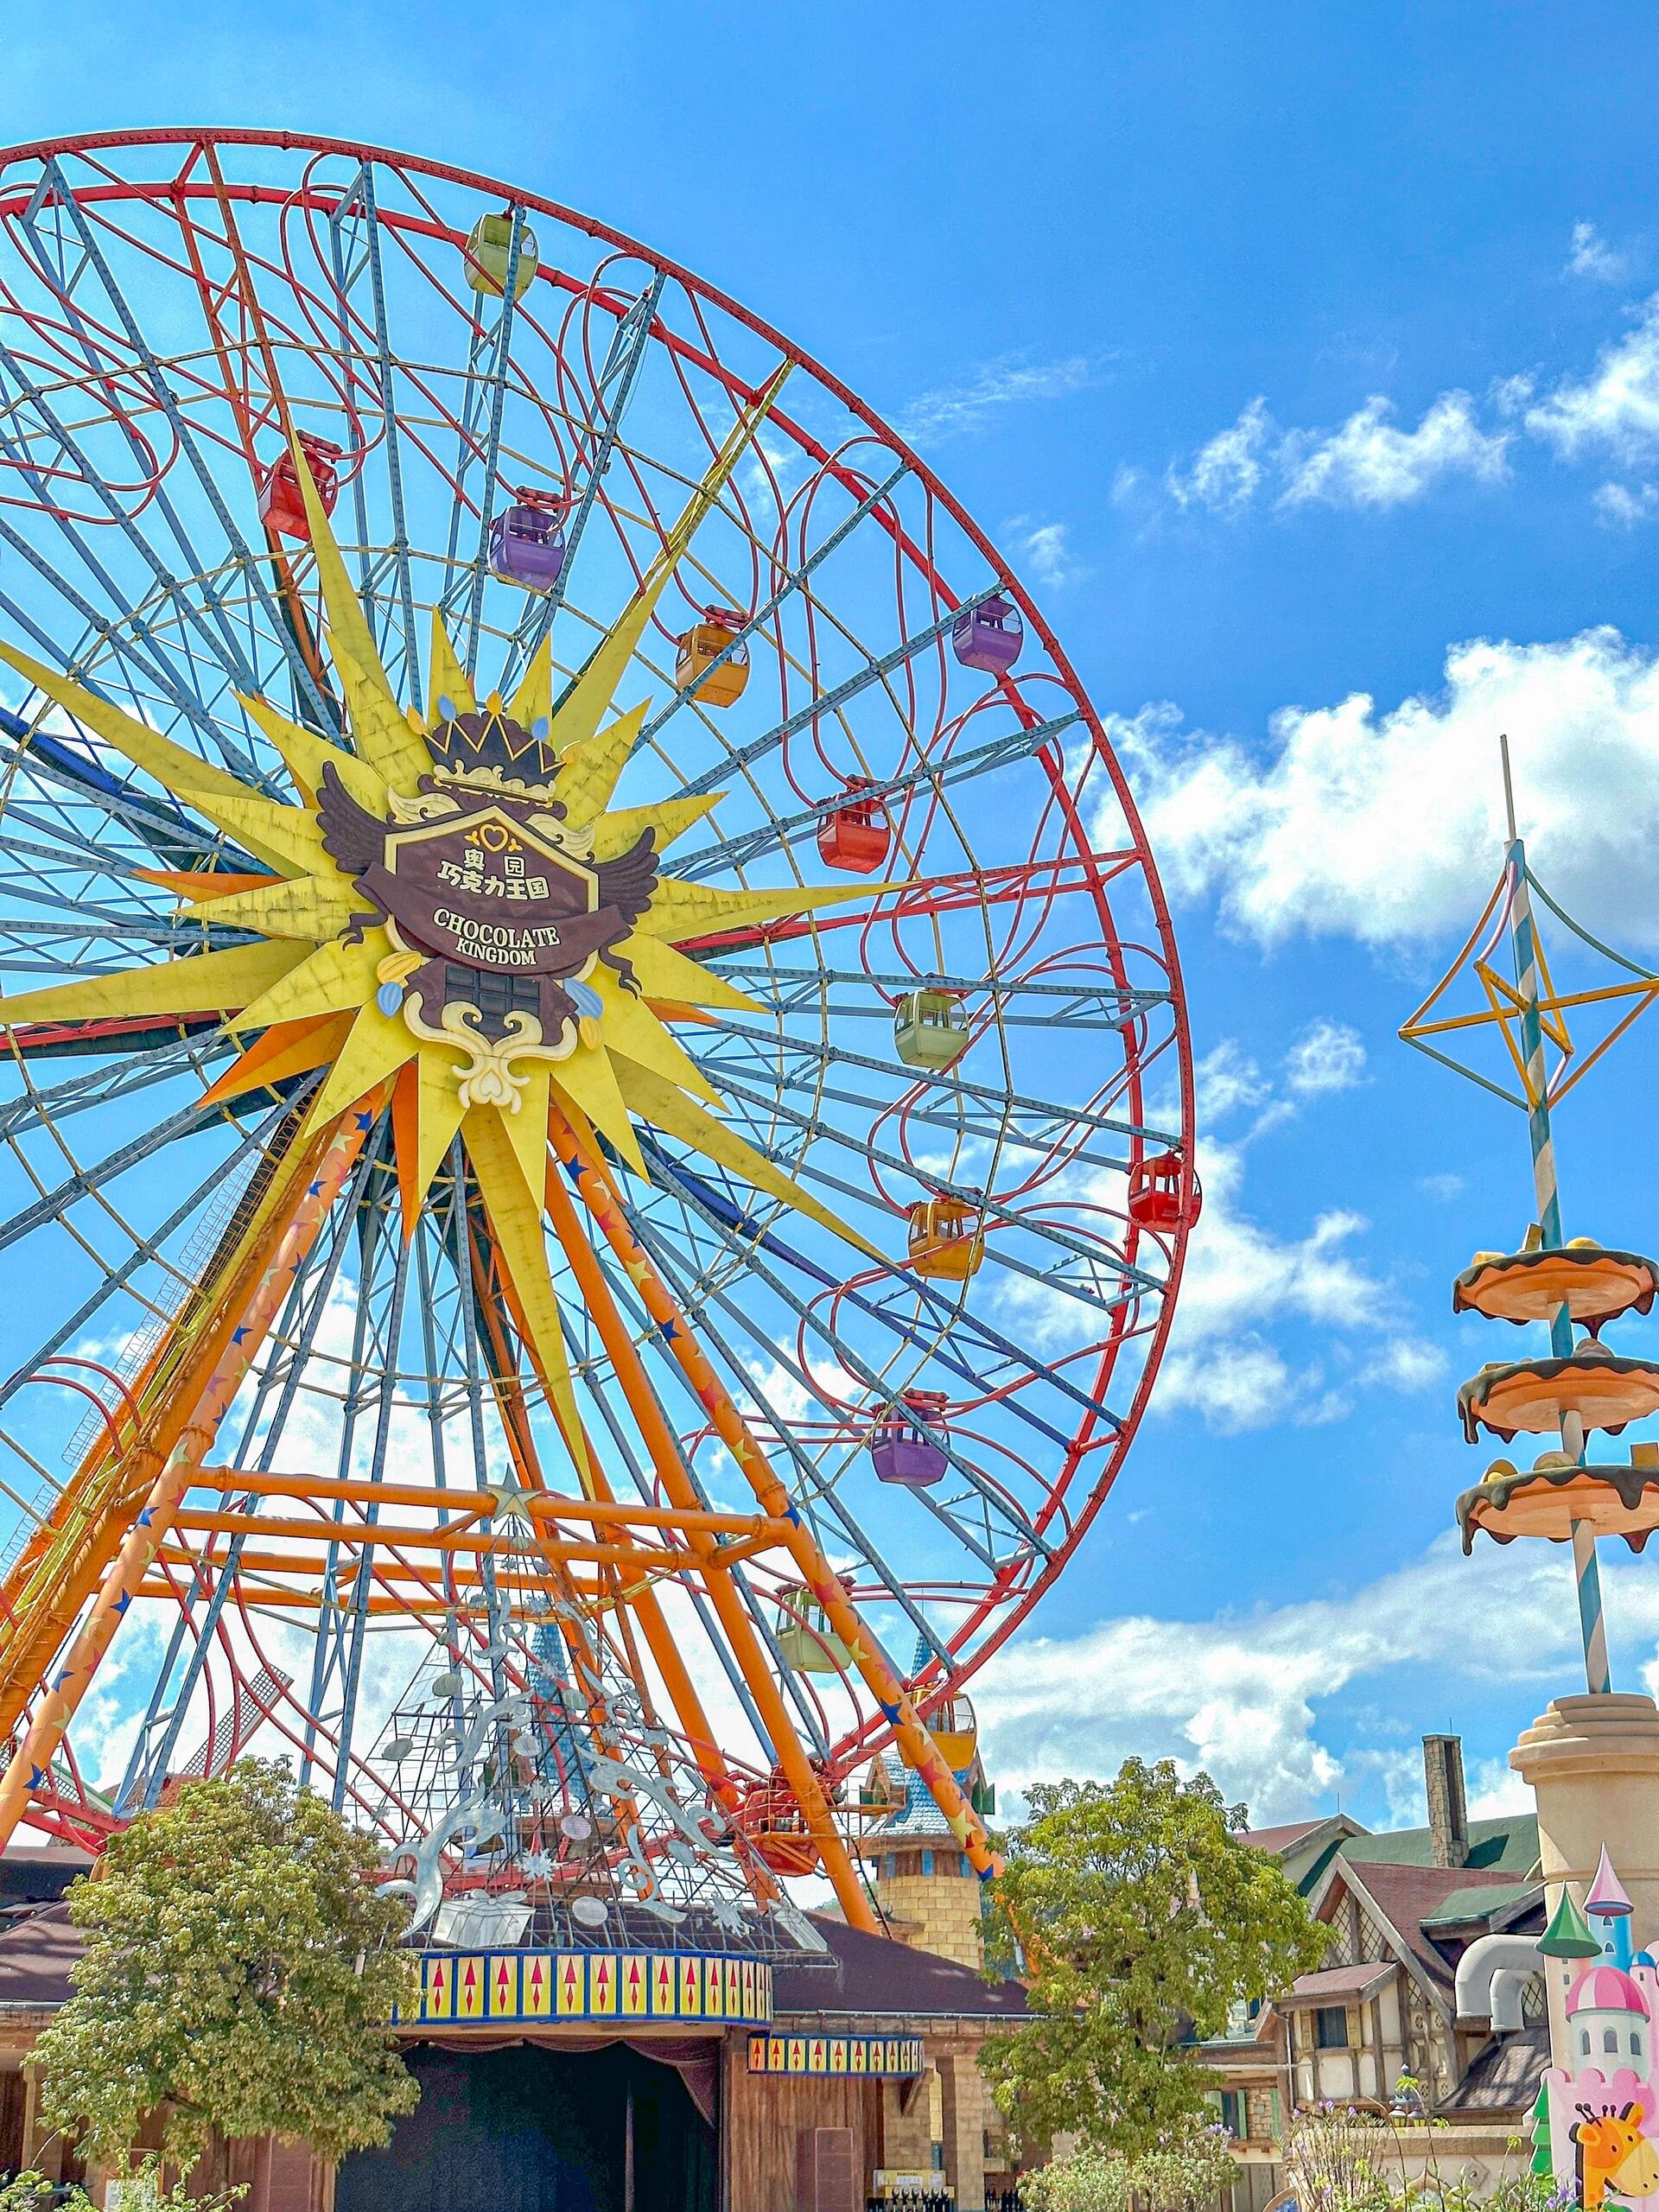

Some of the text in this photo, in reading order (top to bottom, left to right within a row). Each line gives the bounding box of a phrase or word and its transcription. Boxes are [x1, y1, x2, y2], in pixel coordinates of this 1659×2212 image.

[436, 860, 550, 900] 巧克力王国
[463, 848, 525, 879] 奥园
[434, 908, 560, 949] CHOCOLATE
[455, 937, 537, 965] KINGDOM
